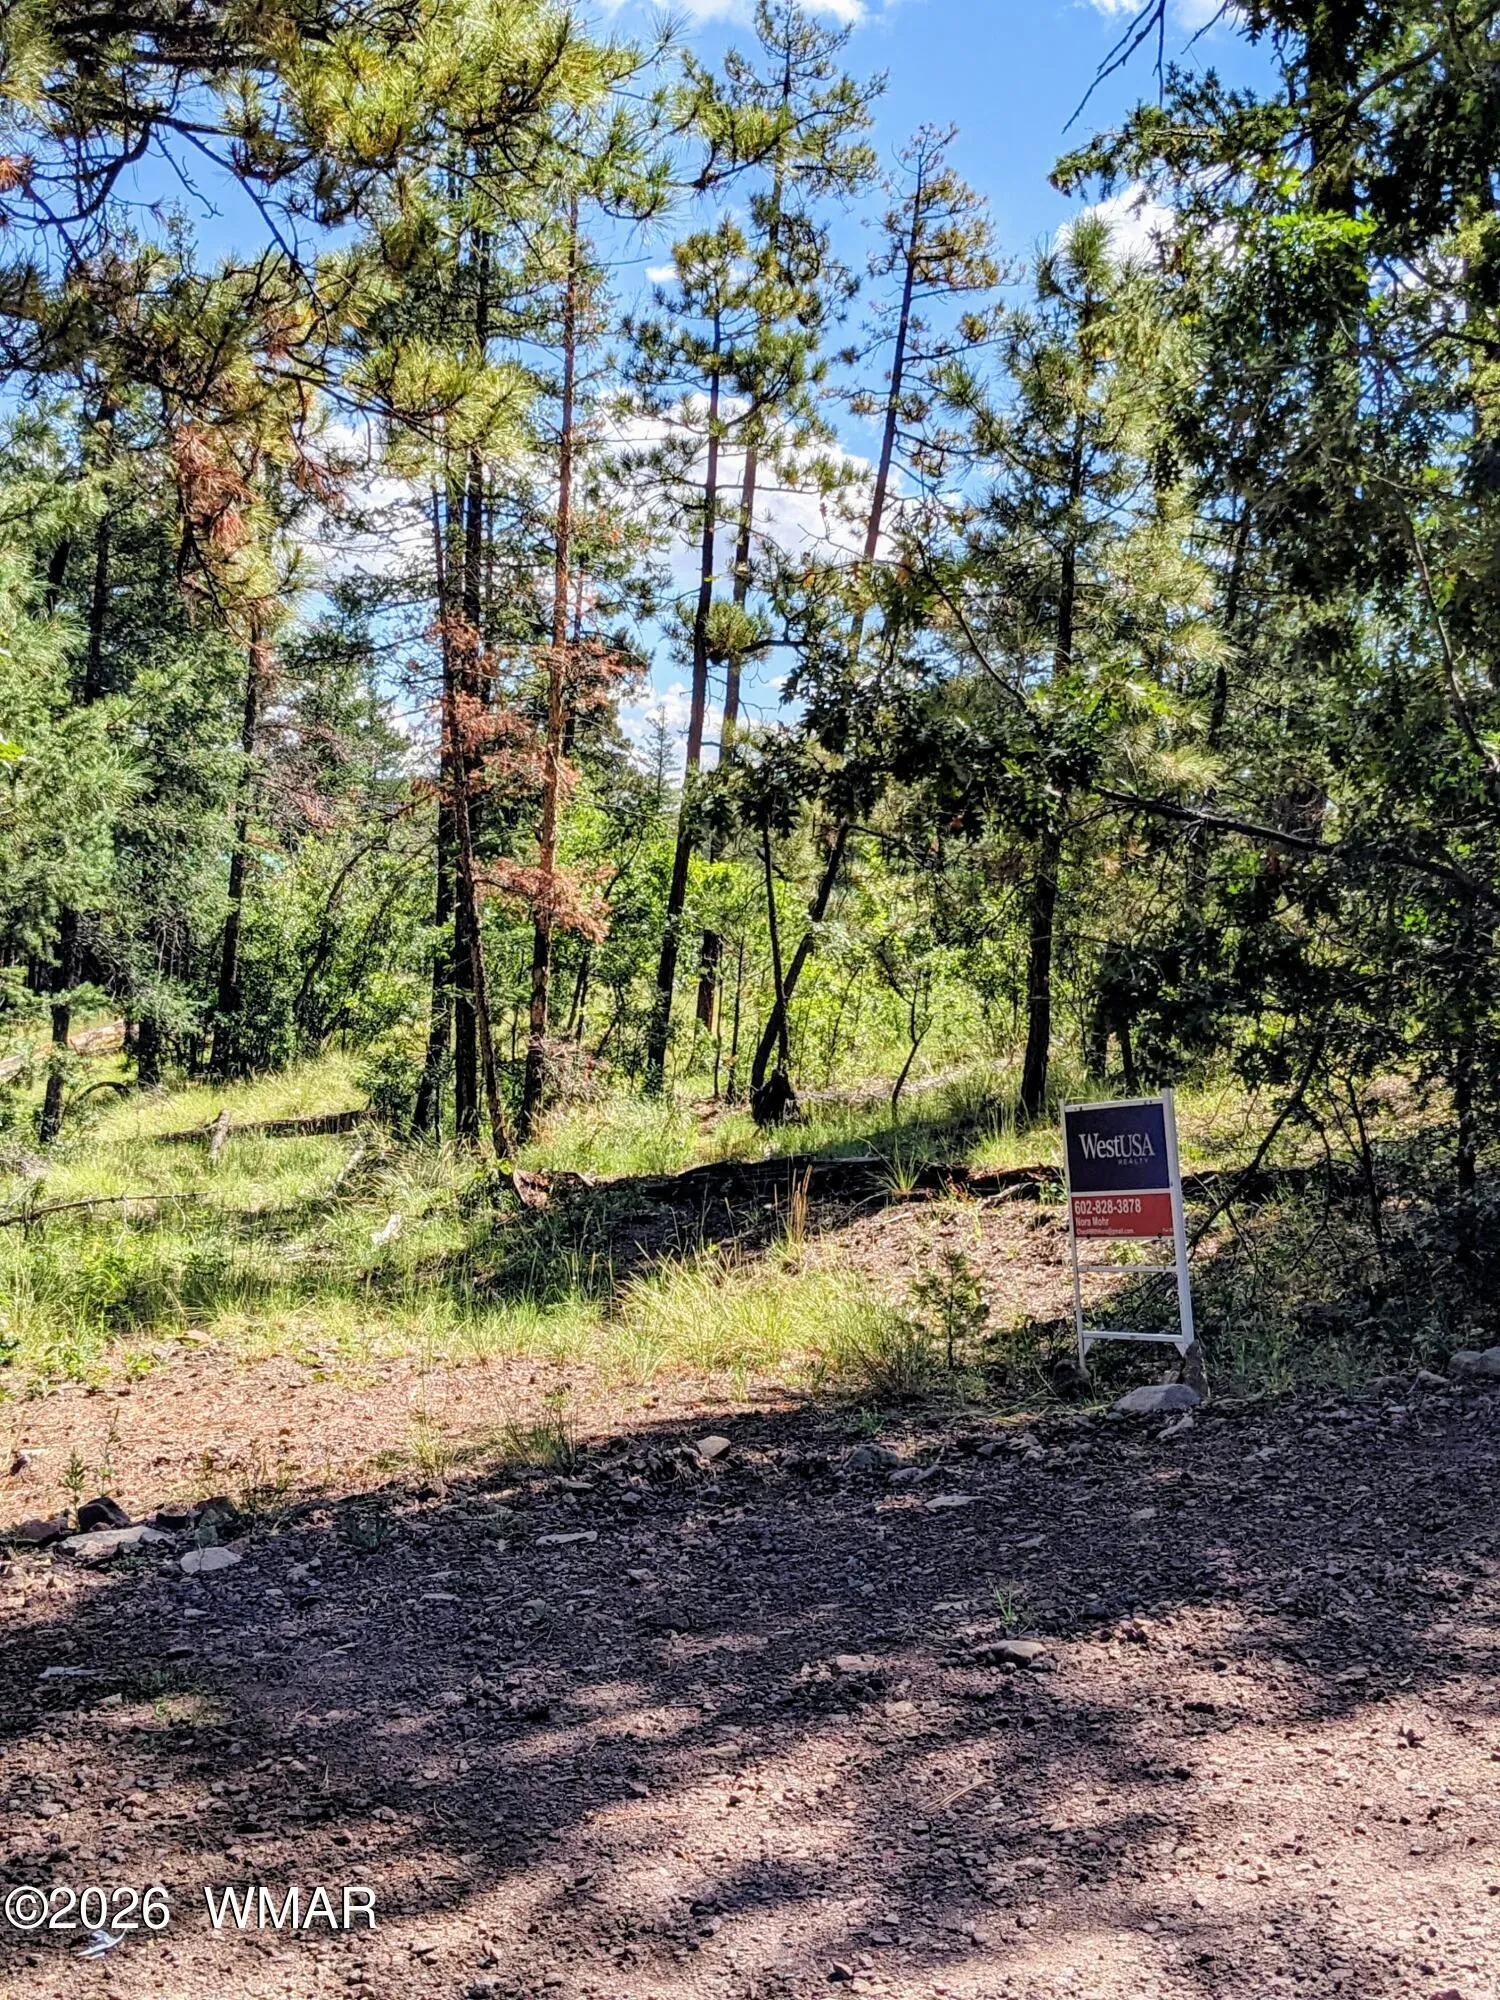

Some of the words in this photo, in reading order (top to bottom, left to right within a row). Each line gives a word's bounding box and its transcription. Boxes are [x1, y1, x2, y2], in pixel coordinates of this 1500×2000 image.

[1078, 1132, 1155, 1159] WestUSA
[1074, 1199, 1141, 1215] 602-828-3878
[1075, 1217, 1092, 1227] Nora
[1092, 1216, 1109, 1227] Mohr
